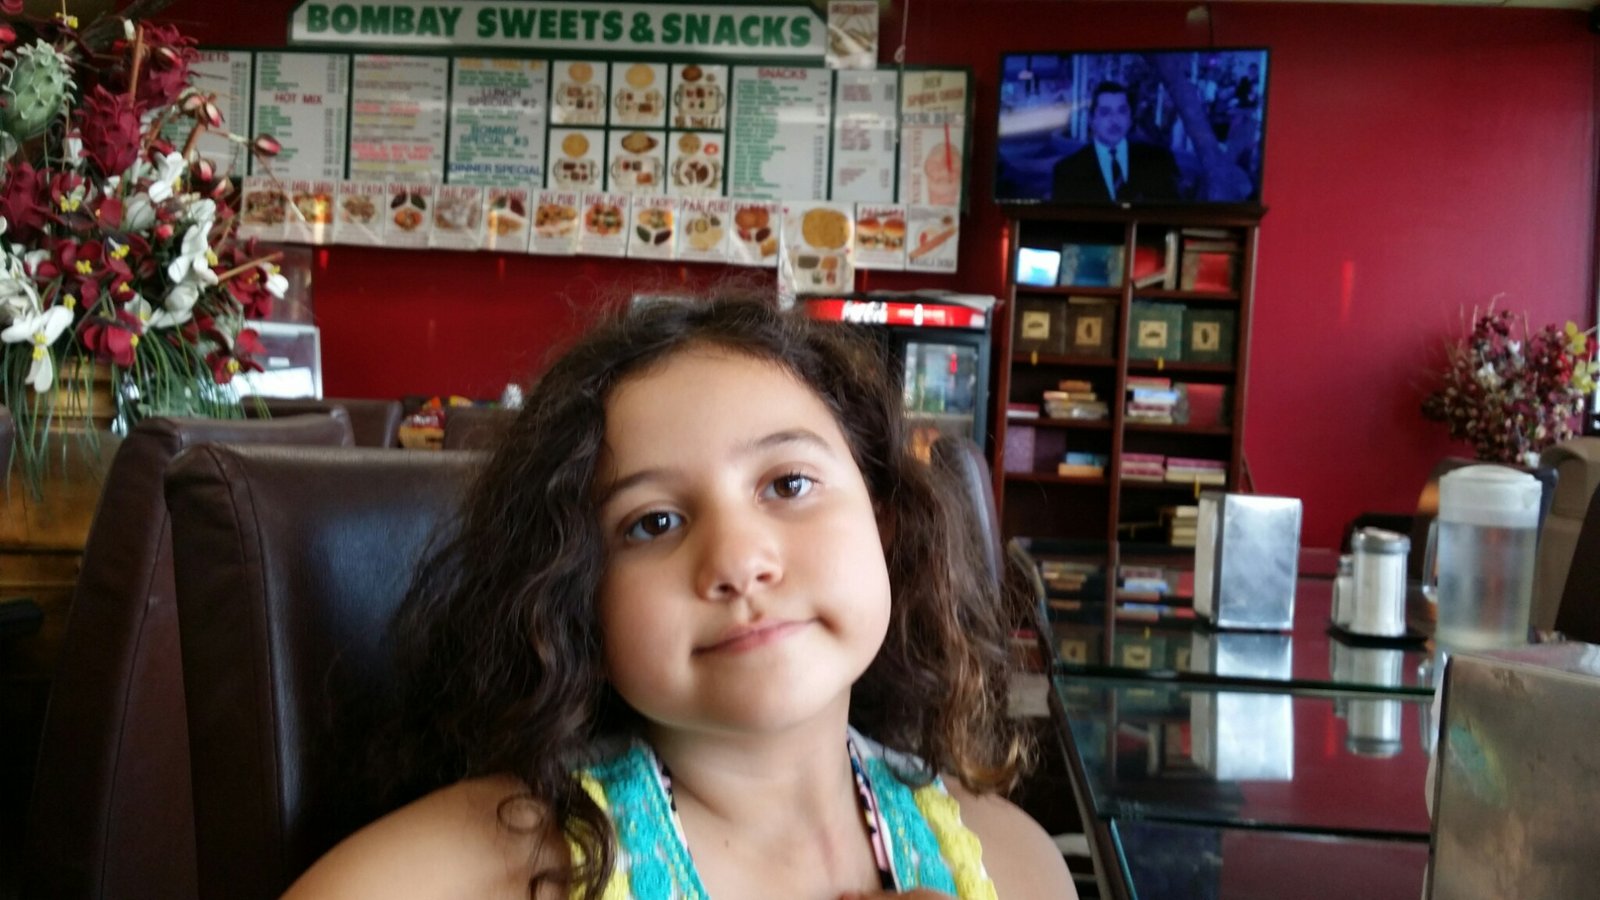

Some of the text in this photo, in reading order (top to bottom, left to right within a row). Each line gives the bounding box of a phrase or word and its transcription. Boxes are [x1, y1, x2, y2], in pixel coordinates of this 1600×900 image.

[306, 5, 811, 47] BOMBAY SWEETS & SNACKS
[757, 68, 807, 80] SNACKS
[275, 93, 323, 104] HOT MIX
[480, 88, 521, 98] LUNCH
[468, 96, 513, 106] SPECIAL
[471, 126, 518, 135] BOMBAY
[450, 162, 539, 175] DINNER SPECIAL
